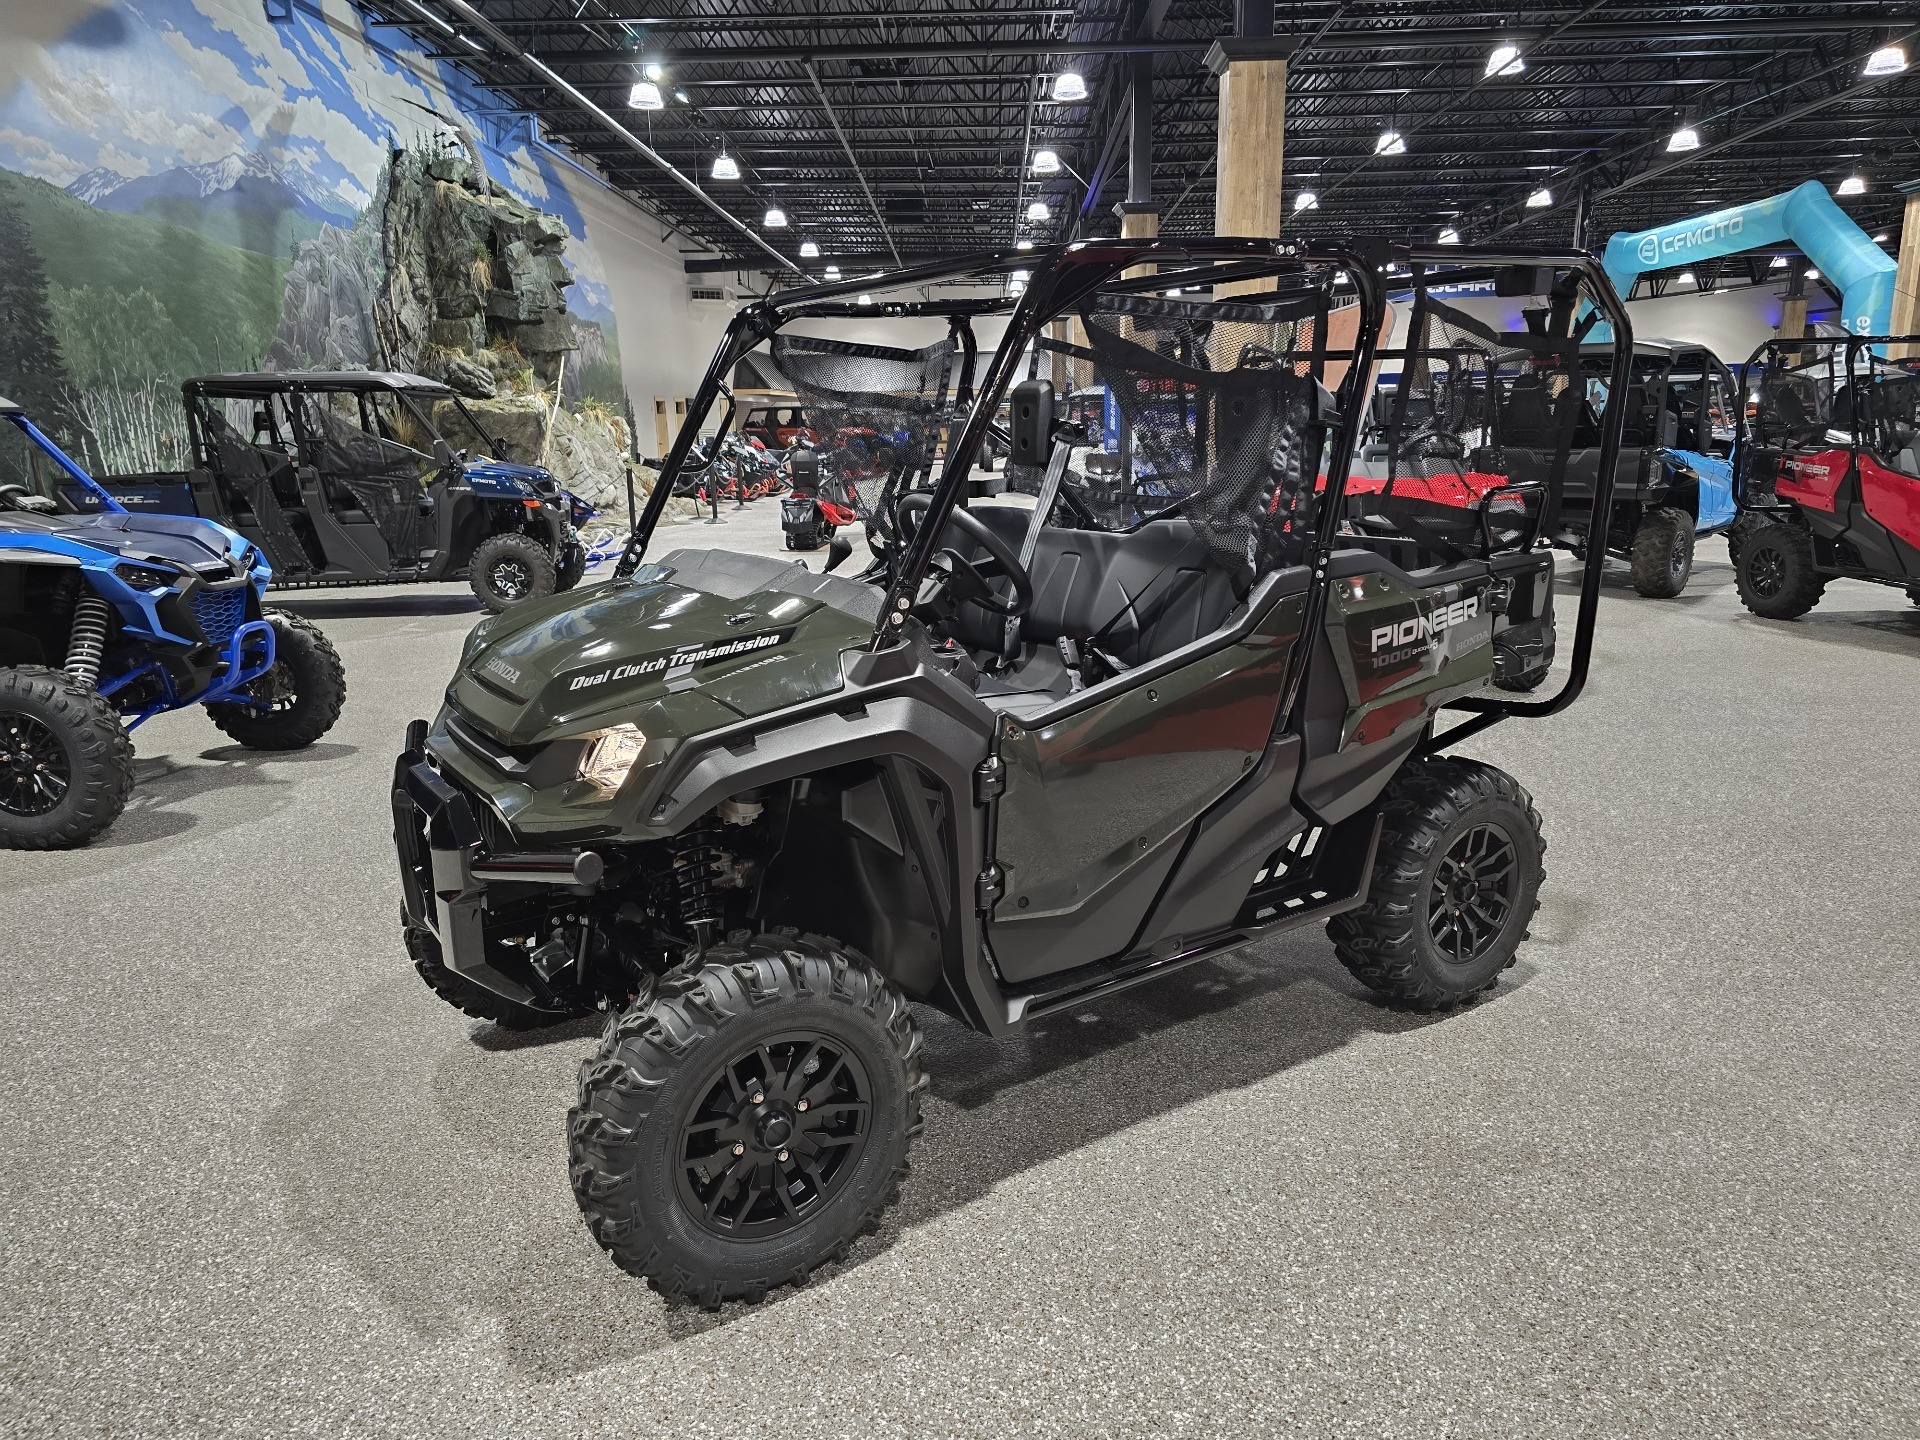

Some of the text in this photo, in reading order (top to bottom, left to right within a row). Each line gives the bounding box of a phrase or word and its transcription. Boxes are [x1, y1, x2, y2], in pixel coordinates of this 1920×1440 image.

[1661, 216, 1744, 254] CFMOTO
[1785, 460, 1830, 475] PIONEER
[84, 495, 144, 504] UFRCE
[1371, 595, 1478, 653] PIONEER
[1455, 630, 1491, 652] HONDA
[485, 656, 521, 684] HONDA
[569, 669, 611, 691] Dual
[612, 657, 666, 680] Clutch
[669, 634, 780, 668] Transmission
[1372, 647, 1412, 669] 1000
